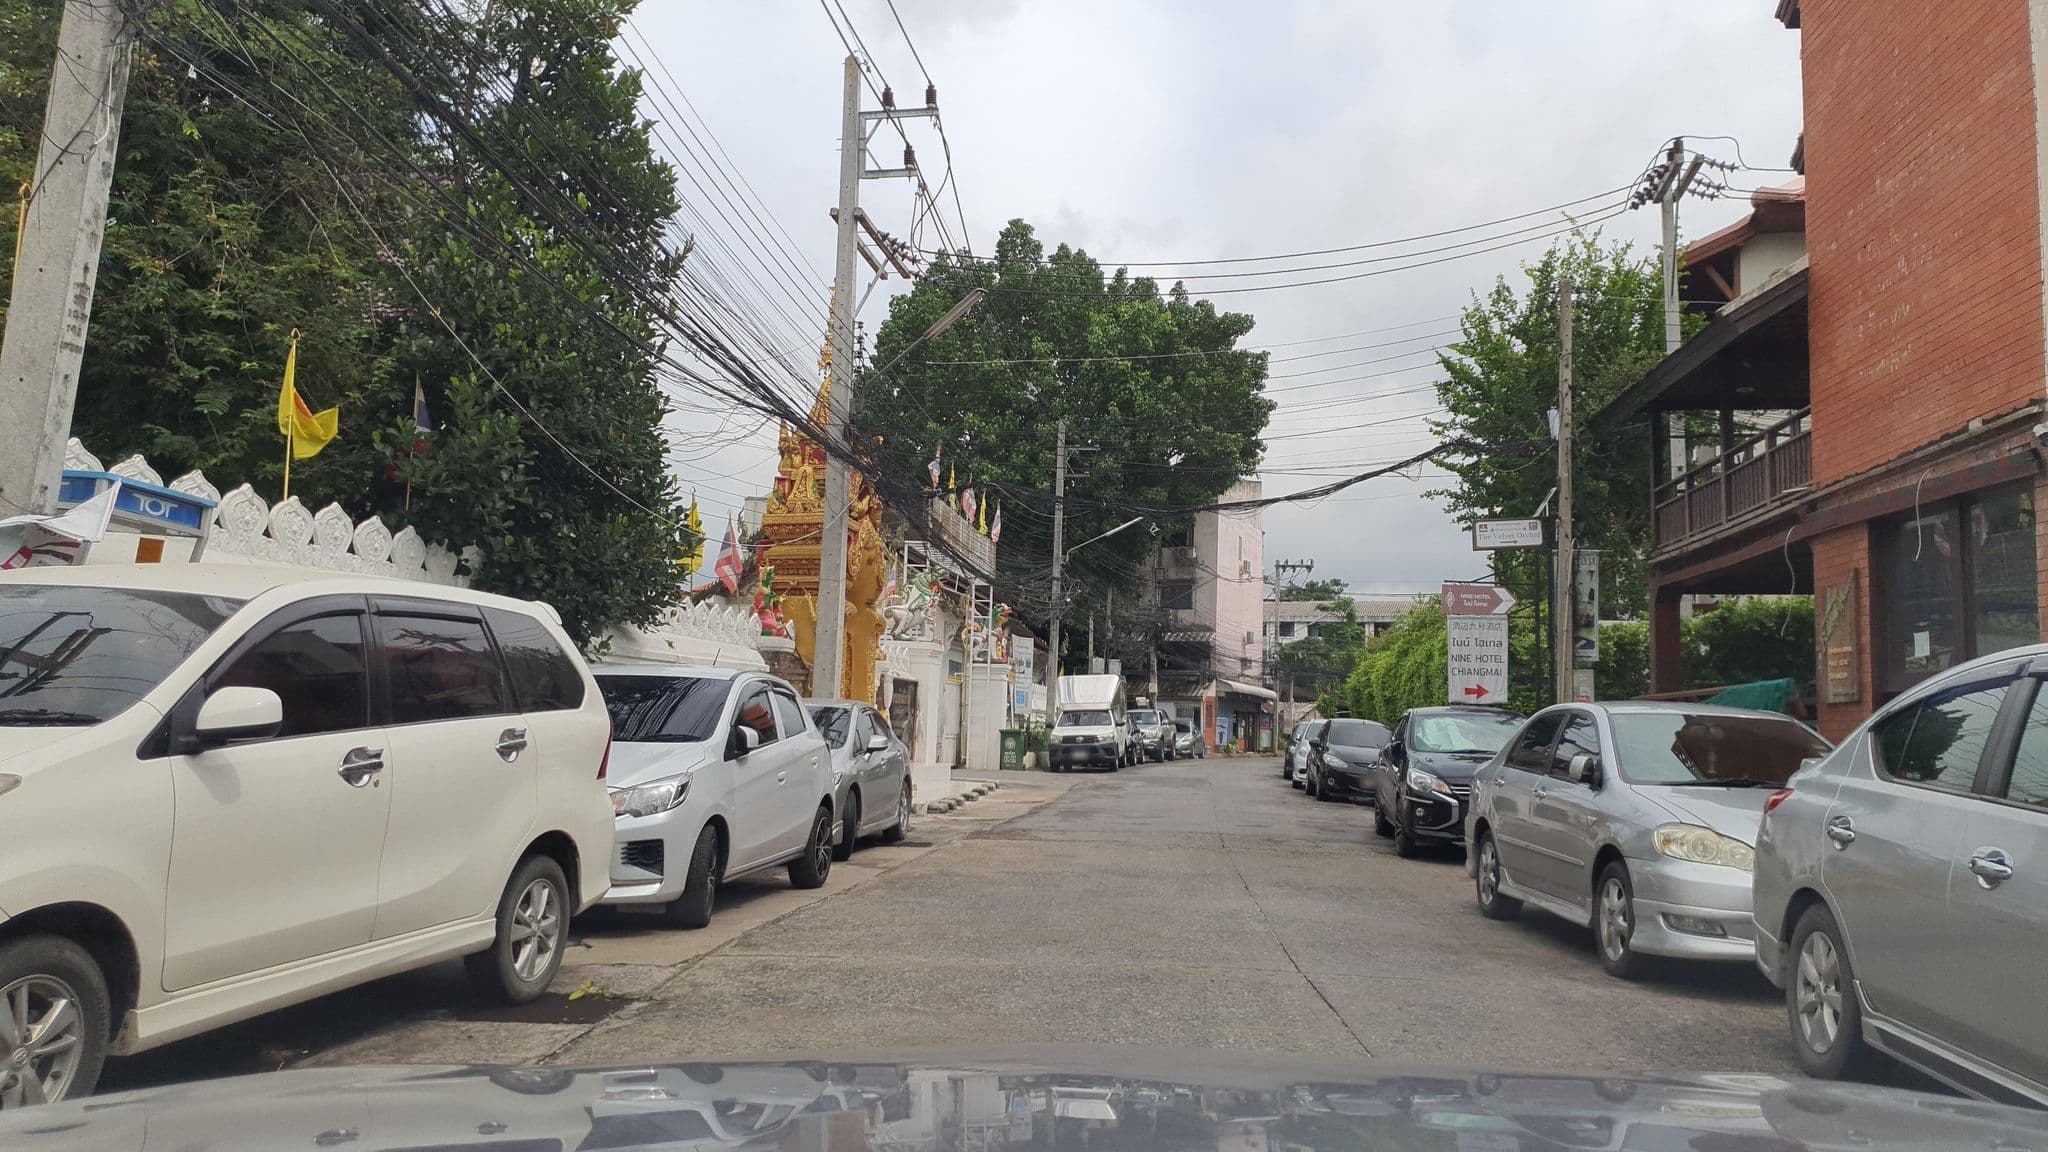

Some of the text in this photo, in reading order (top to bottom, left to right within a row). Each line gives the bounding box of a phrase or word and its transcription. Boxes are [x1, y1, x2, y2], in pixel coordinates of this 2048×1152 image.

[132, 493, 179, 518] TOT
[1451, 654, 1504, 663] NINE HOTEL
[1451, 667, 1503, 676] CHIANGMAI
